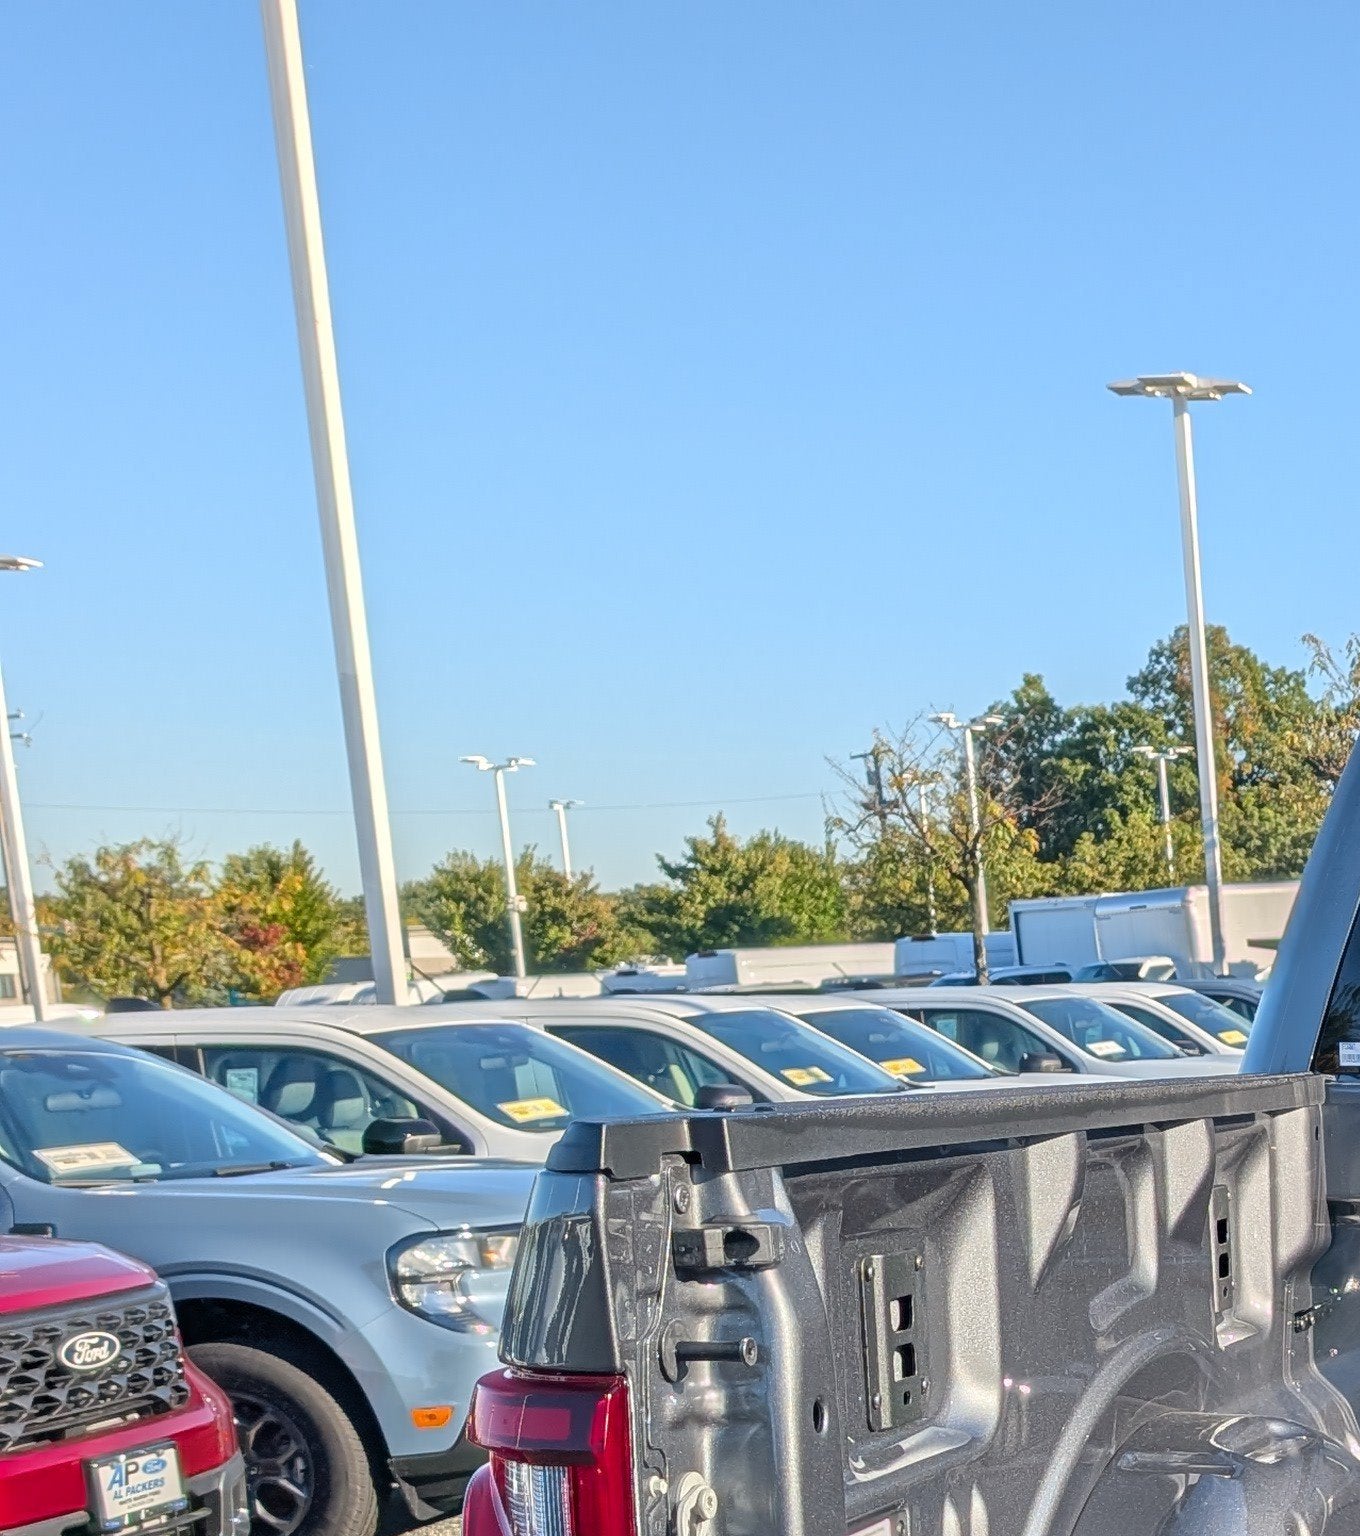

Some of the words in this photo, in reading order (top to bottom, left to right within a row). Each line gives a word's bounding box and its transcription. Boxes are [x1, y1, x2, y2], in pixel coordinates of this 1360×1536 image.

[73, 1337, 110, 1364] Ford
[107, 1461, 139, 1491] AP
[113, 1490, 123, 1501] AL
